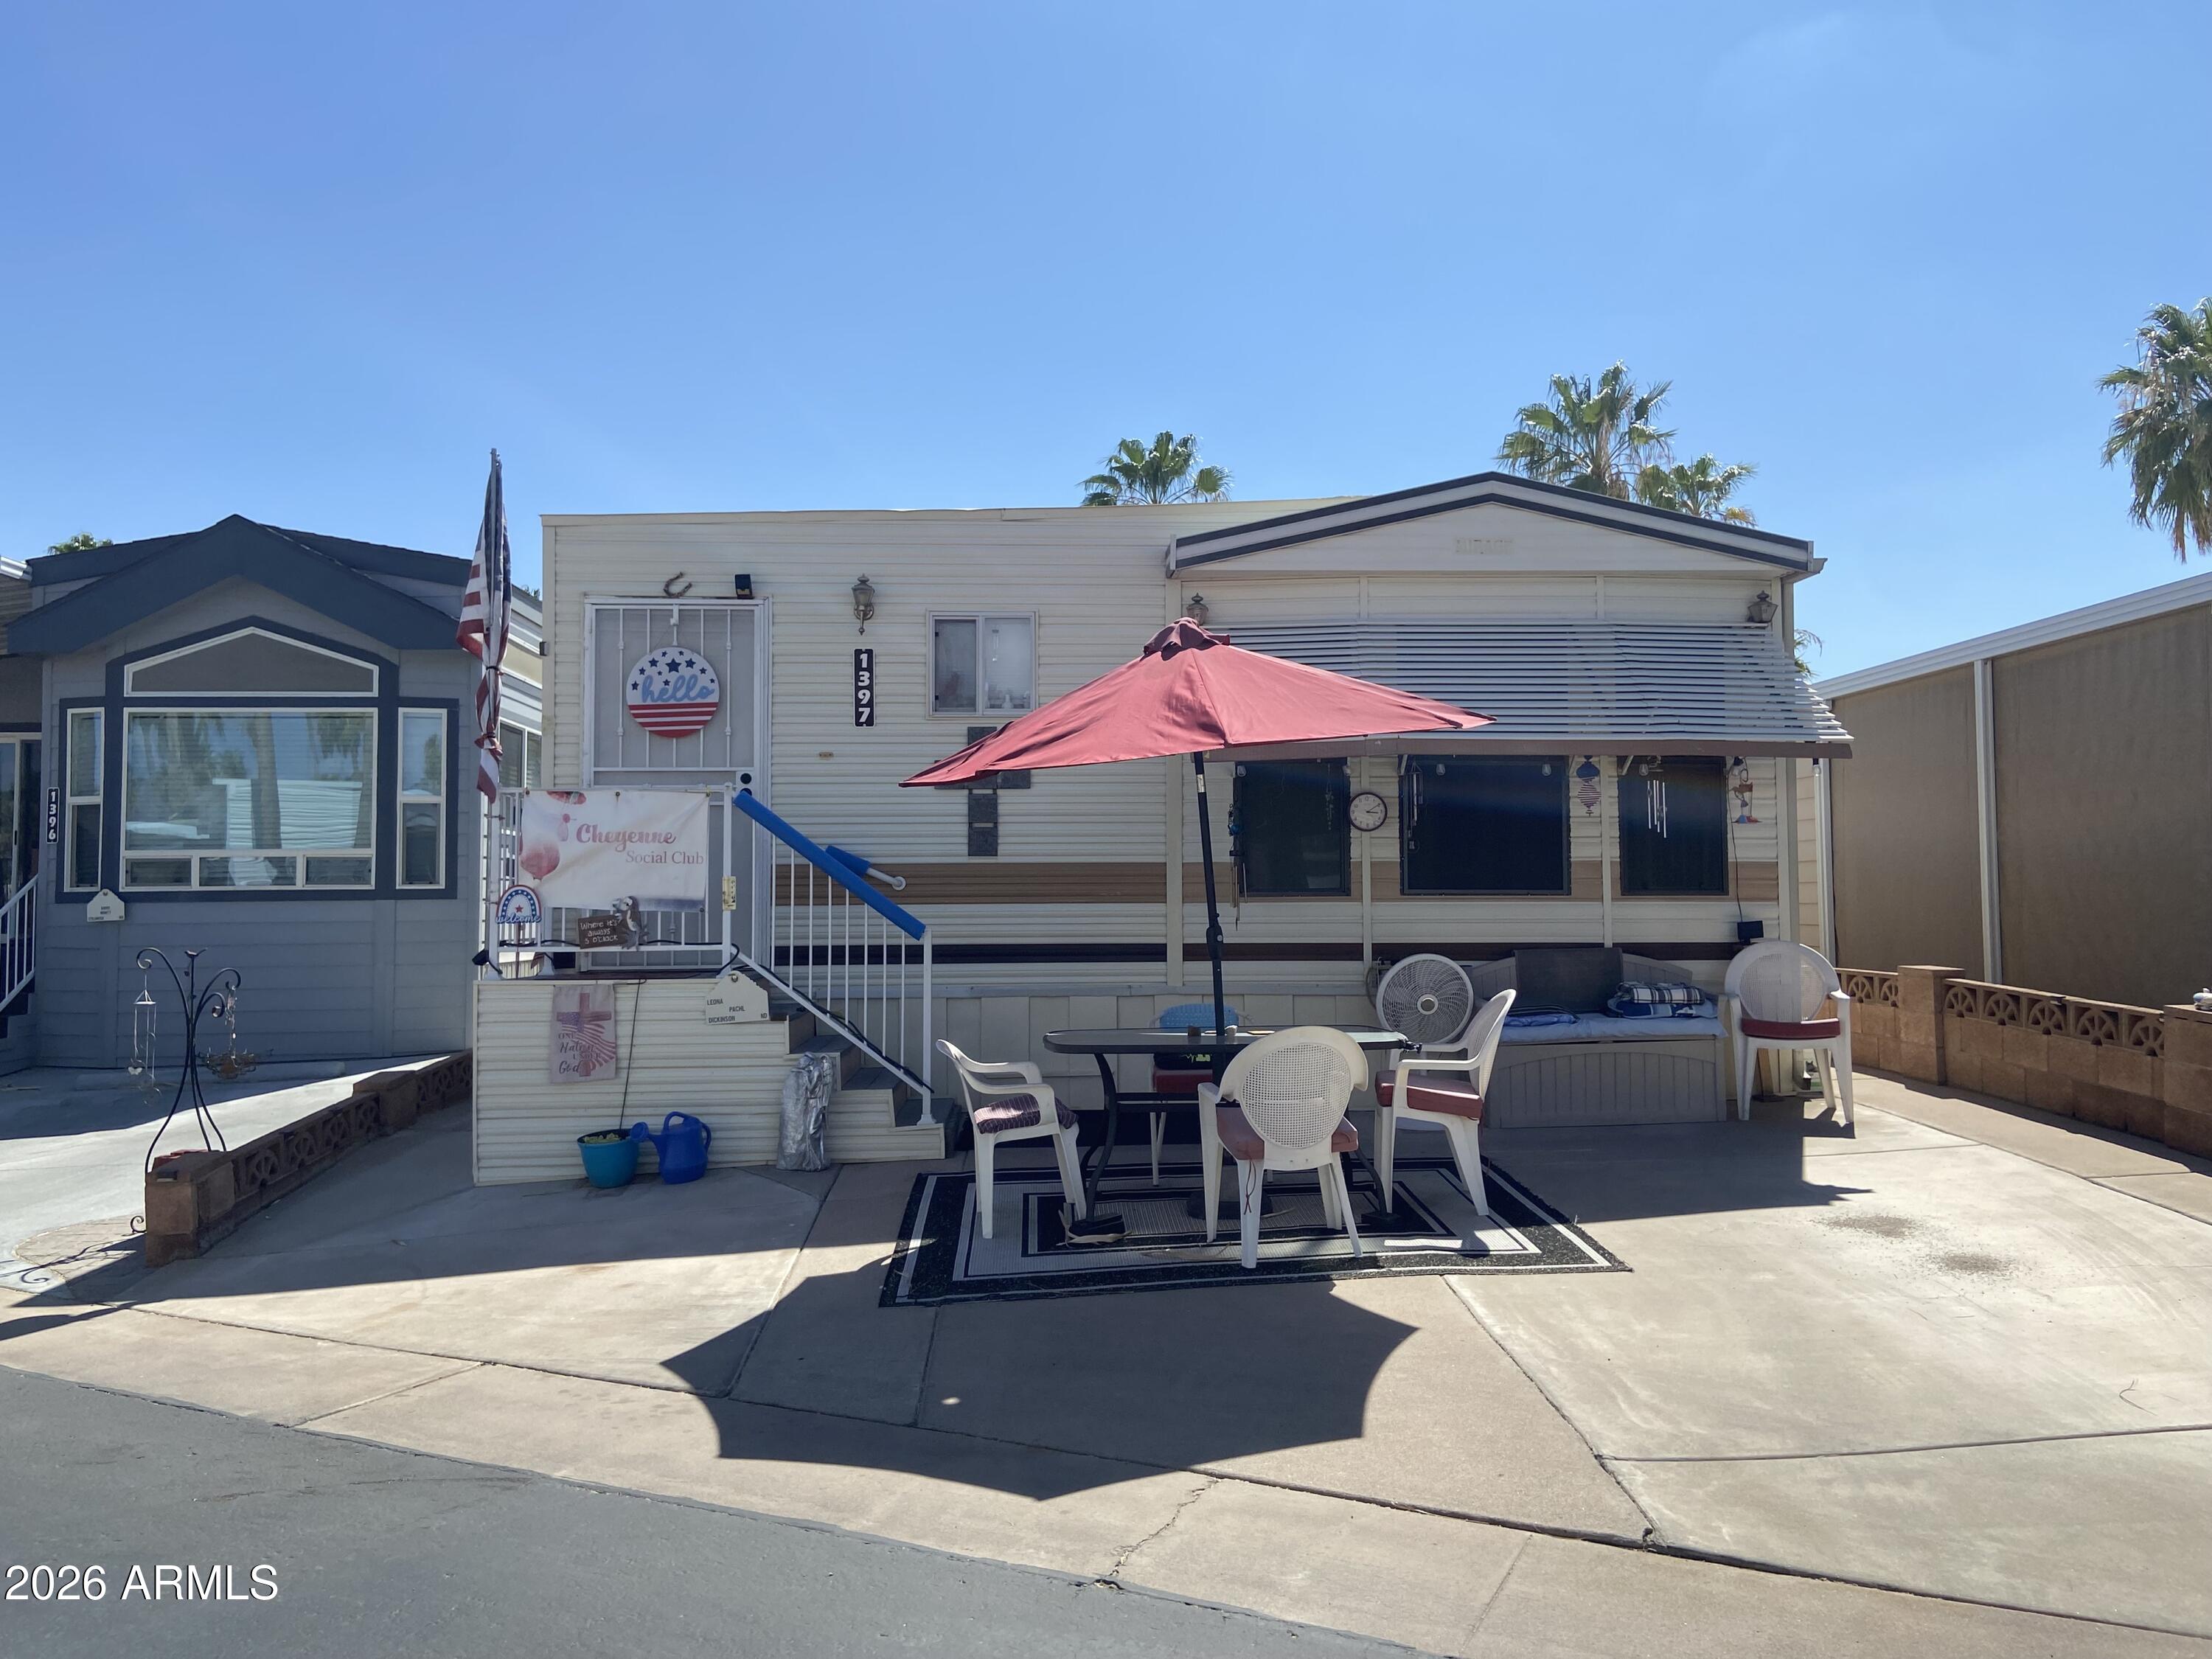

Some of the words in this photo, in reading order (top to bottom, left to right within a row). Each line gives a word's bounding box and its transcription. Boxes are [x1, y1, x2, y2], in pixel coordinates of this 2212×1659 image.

[641, 674, 715, 703] hello
[858, 653, 871, 722] 1397
[49, 791, 57, 840] 1396
[576, 824, 676, 852] Cheyenne
[626, 849, 667, 864] Social
[672, 851, 704, 865] Club
[495, 913, 542, 923] welcome
[580, 922, 604, 930] Where
[588, 928, 611, 937] always
[559, 1060, 584, 1074] God
